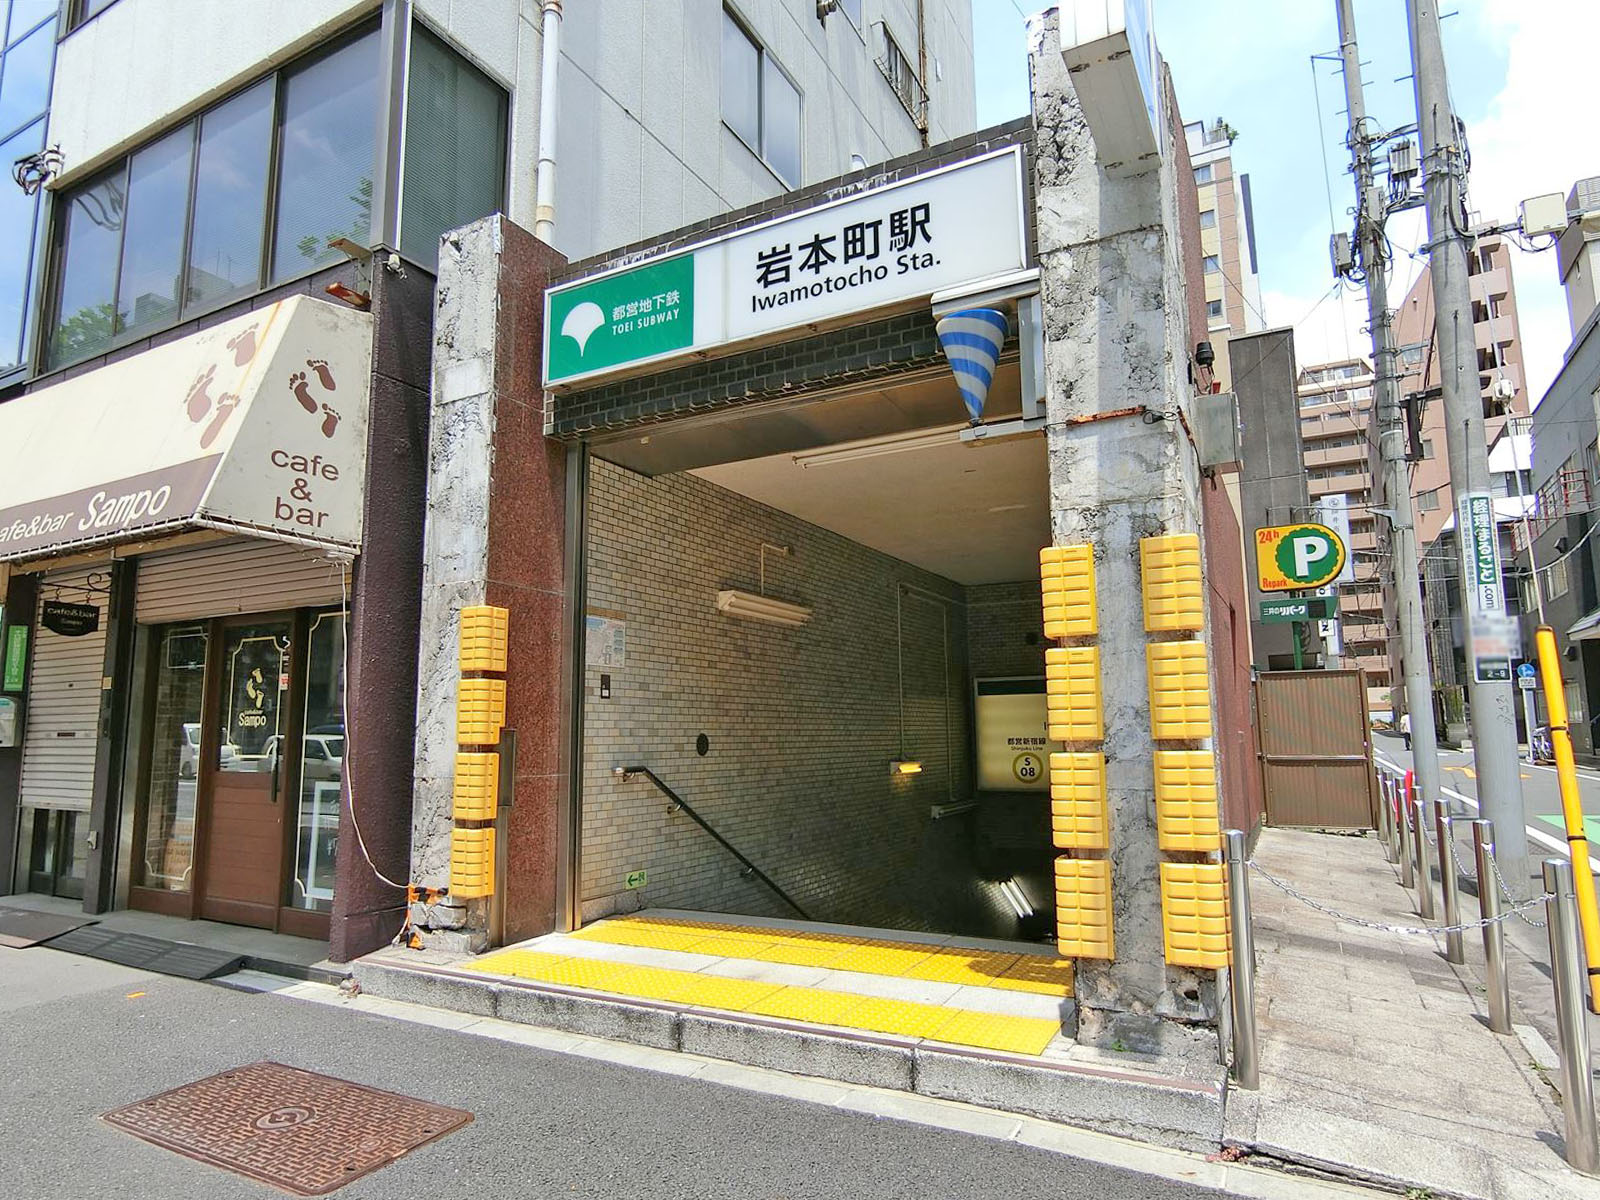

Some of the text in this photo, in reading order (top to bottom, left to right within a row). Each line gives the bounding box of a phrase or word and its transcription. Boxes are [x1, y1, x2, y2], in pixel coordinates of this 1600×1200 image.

[756, 202, 932, 289] 岩本町駅
[752, 251, 941, 313] Iwamotocho Sta.
[612, 289, 680, 321] 都営地下鉄
[612, 308, 680, 336] TOEI SUBWAY
[271, 450, 339, 481] cafe
[290, 477, 312, 502] &
[78, 485, 171, 531] Sampo
[275, 496, 329, 528] bar
[1258, 530, 1279, 544] 24h
[1293, 536, 1329, 577] P
[1262, 578, 1288, 589] Repark
[1263, 605, 1306, 616] 三井のリパーク
[1020, 767, 1035, 777] 08
[1024, 757, 1031, 766] S
